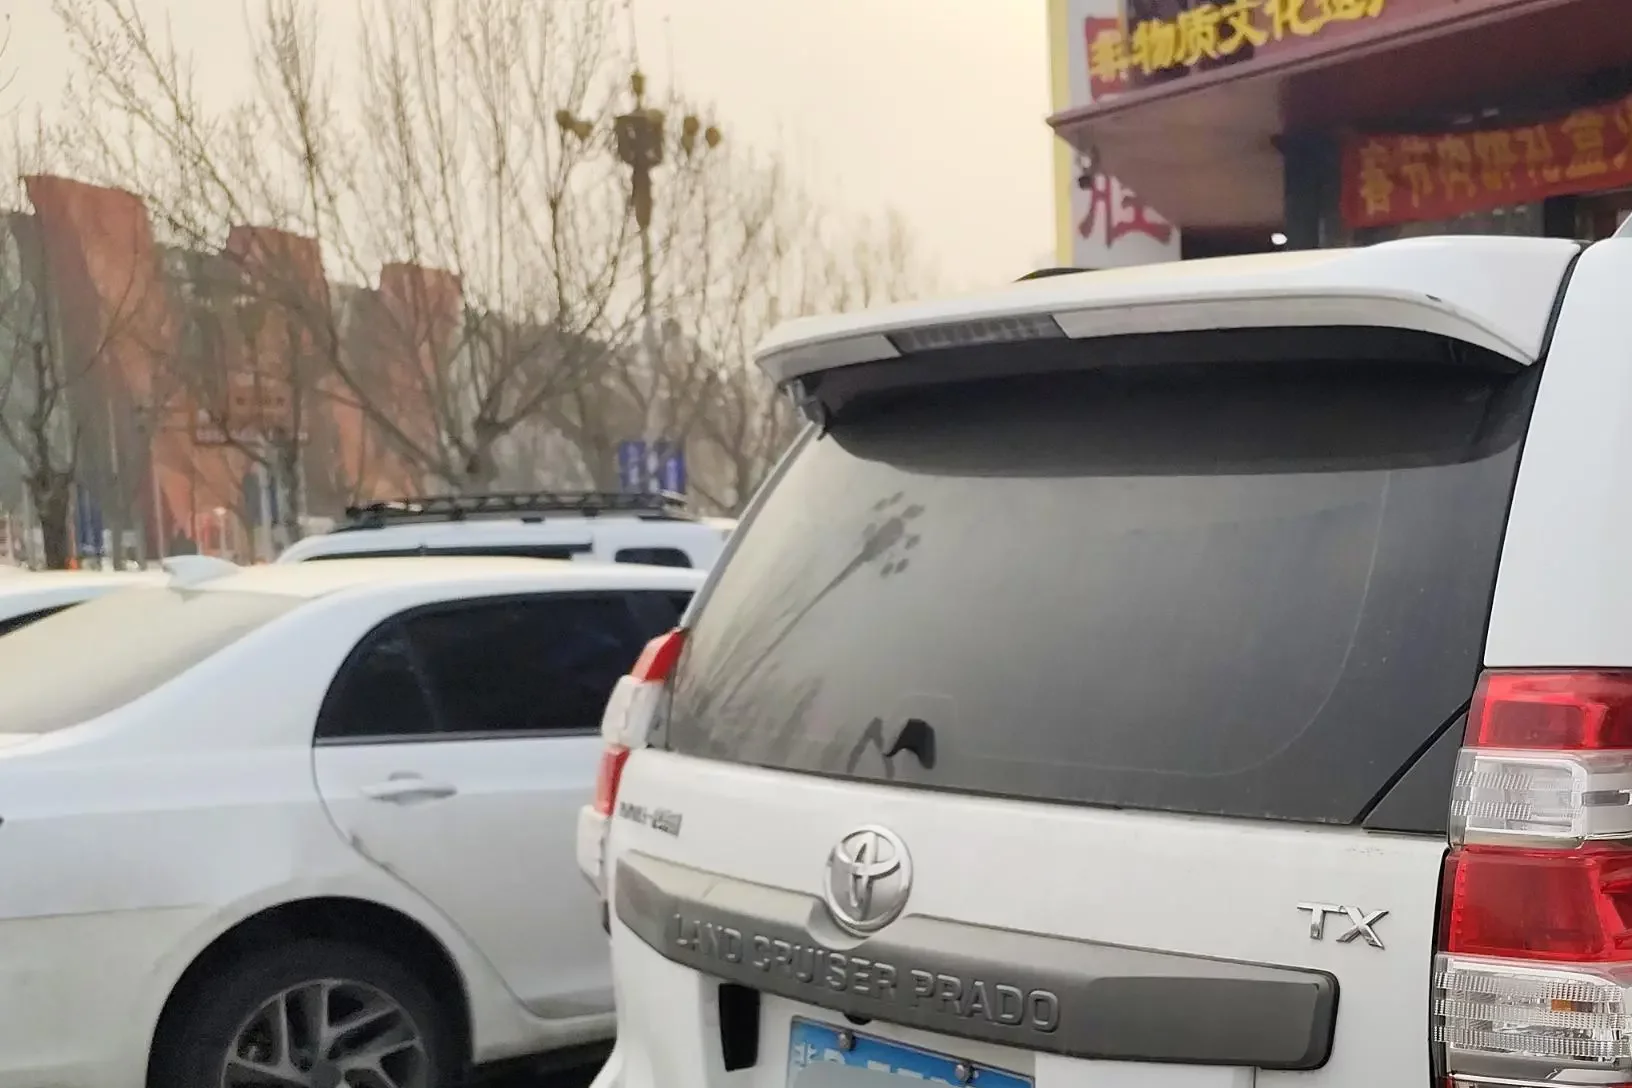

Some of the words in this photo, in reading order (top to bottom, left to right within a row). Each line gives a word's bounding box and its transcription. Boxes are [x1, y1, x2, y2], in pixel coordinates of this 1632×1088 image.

[1297, 901, 1390, 951] TX
[673, 912, 743, 964] LAND
[752, 934, 898, 996] CRUISER
[909, 968, 1062, 1034] PRADO
